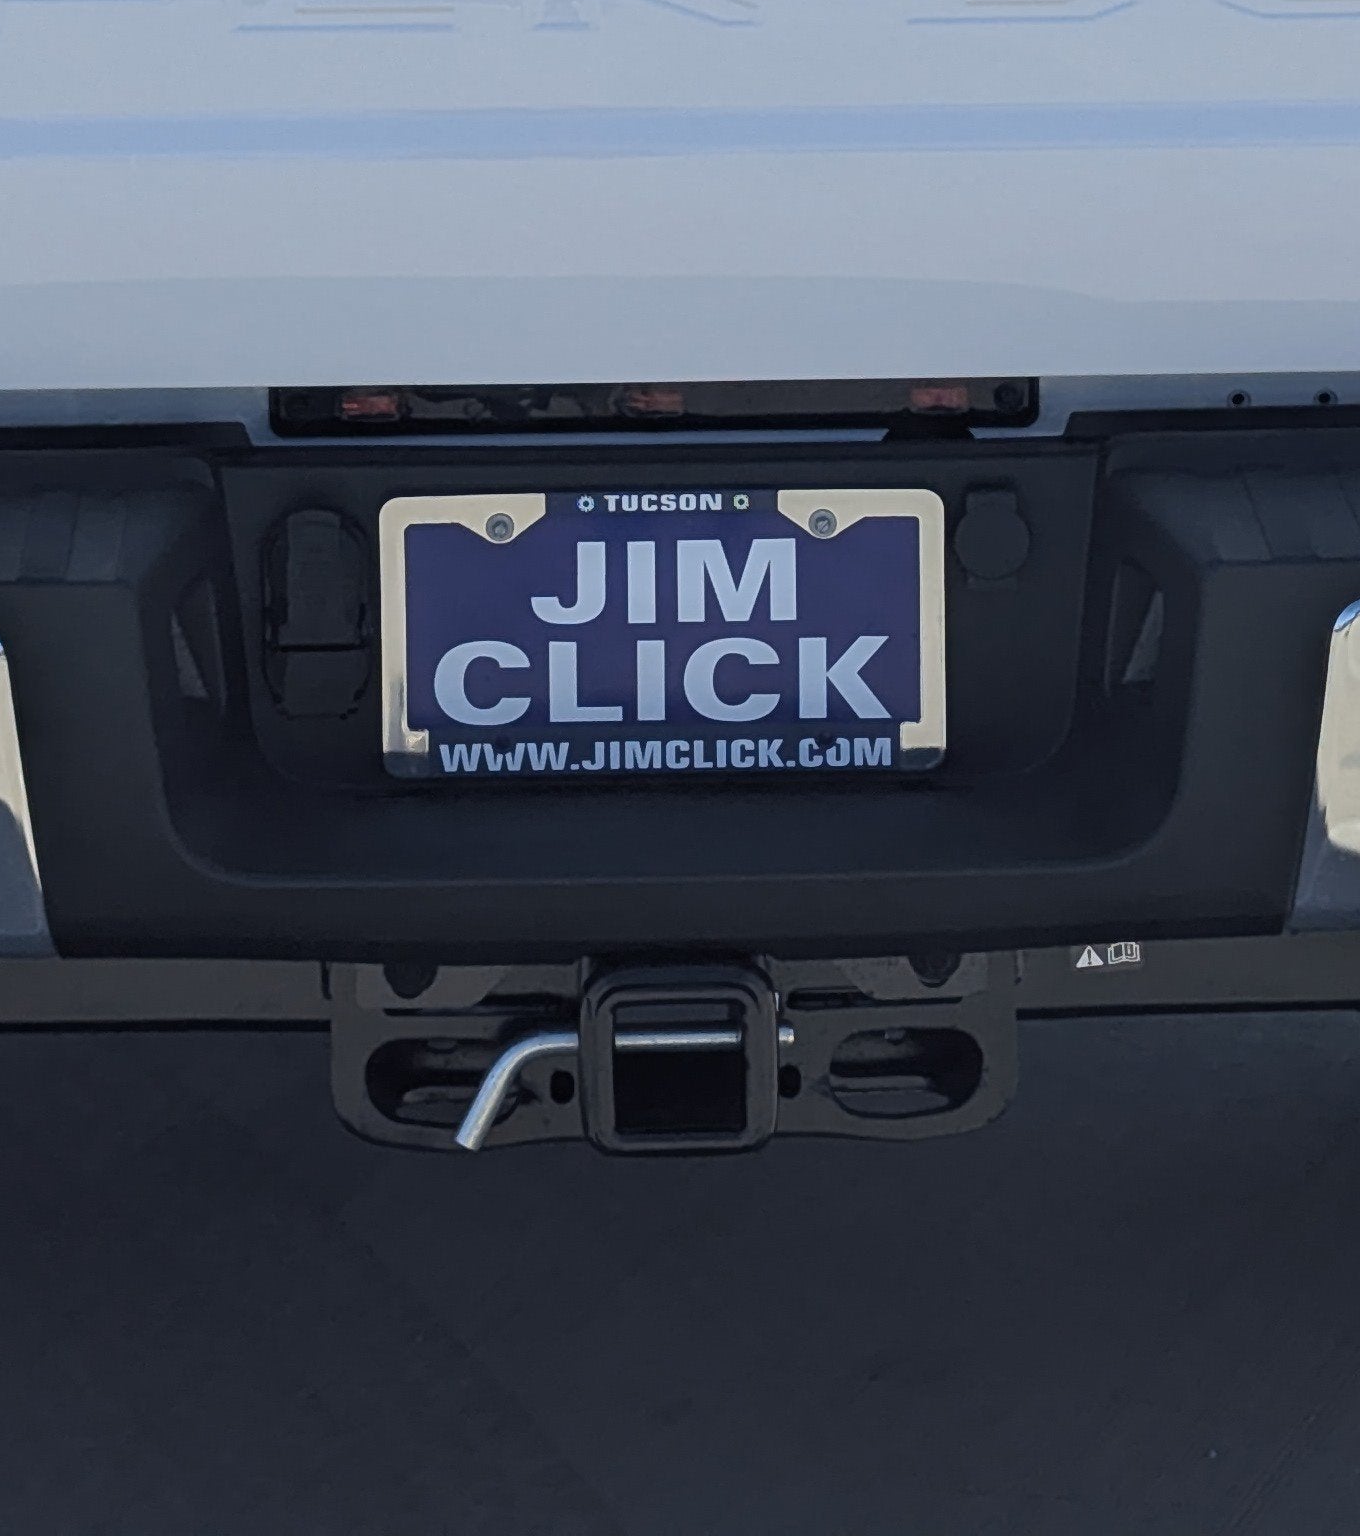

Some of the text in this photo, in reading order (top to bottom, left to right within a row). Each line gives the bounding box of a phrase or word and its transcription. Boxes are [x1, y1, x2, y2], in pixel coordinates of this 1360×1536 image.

[603, 492, 723, 513] TUCSON
[530, 537, 798, 625] JIM
[433, 634, 893, 727] CLICK
[439, 736, 893, 773] WWW.JIMCLICK.COM
